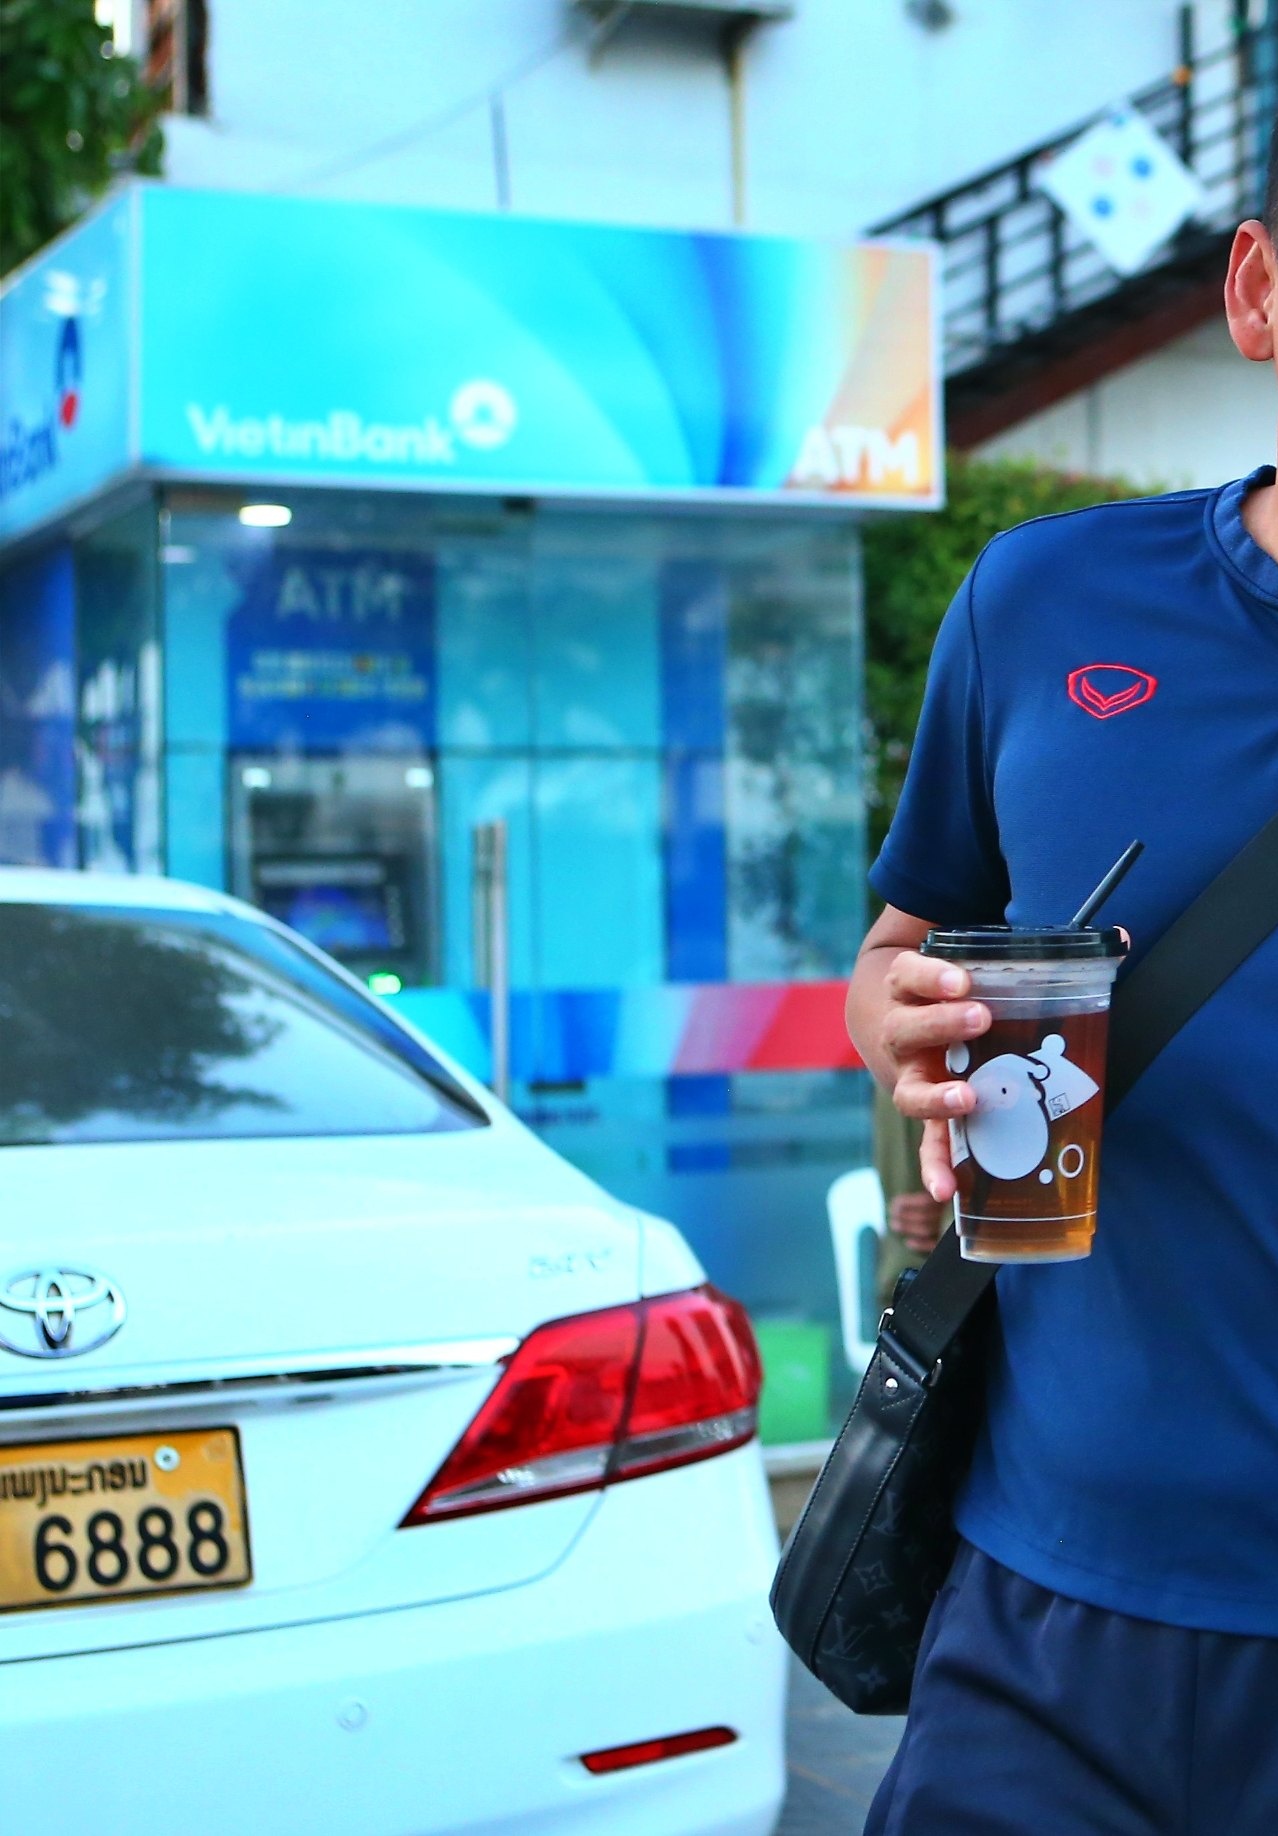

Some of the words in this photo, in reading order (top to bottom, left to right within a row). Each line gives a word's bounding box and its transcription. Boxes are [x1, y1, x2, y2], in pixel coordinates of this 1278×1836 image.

[184, 400, 459, 463] VietinBank
[788, 424, 918, 485] ATM
[276, 566, 404, 622] ATM
[34, 1501, 229, 1593] 6888
